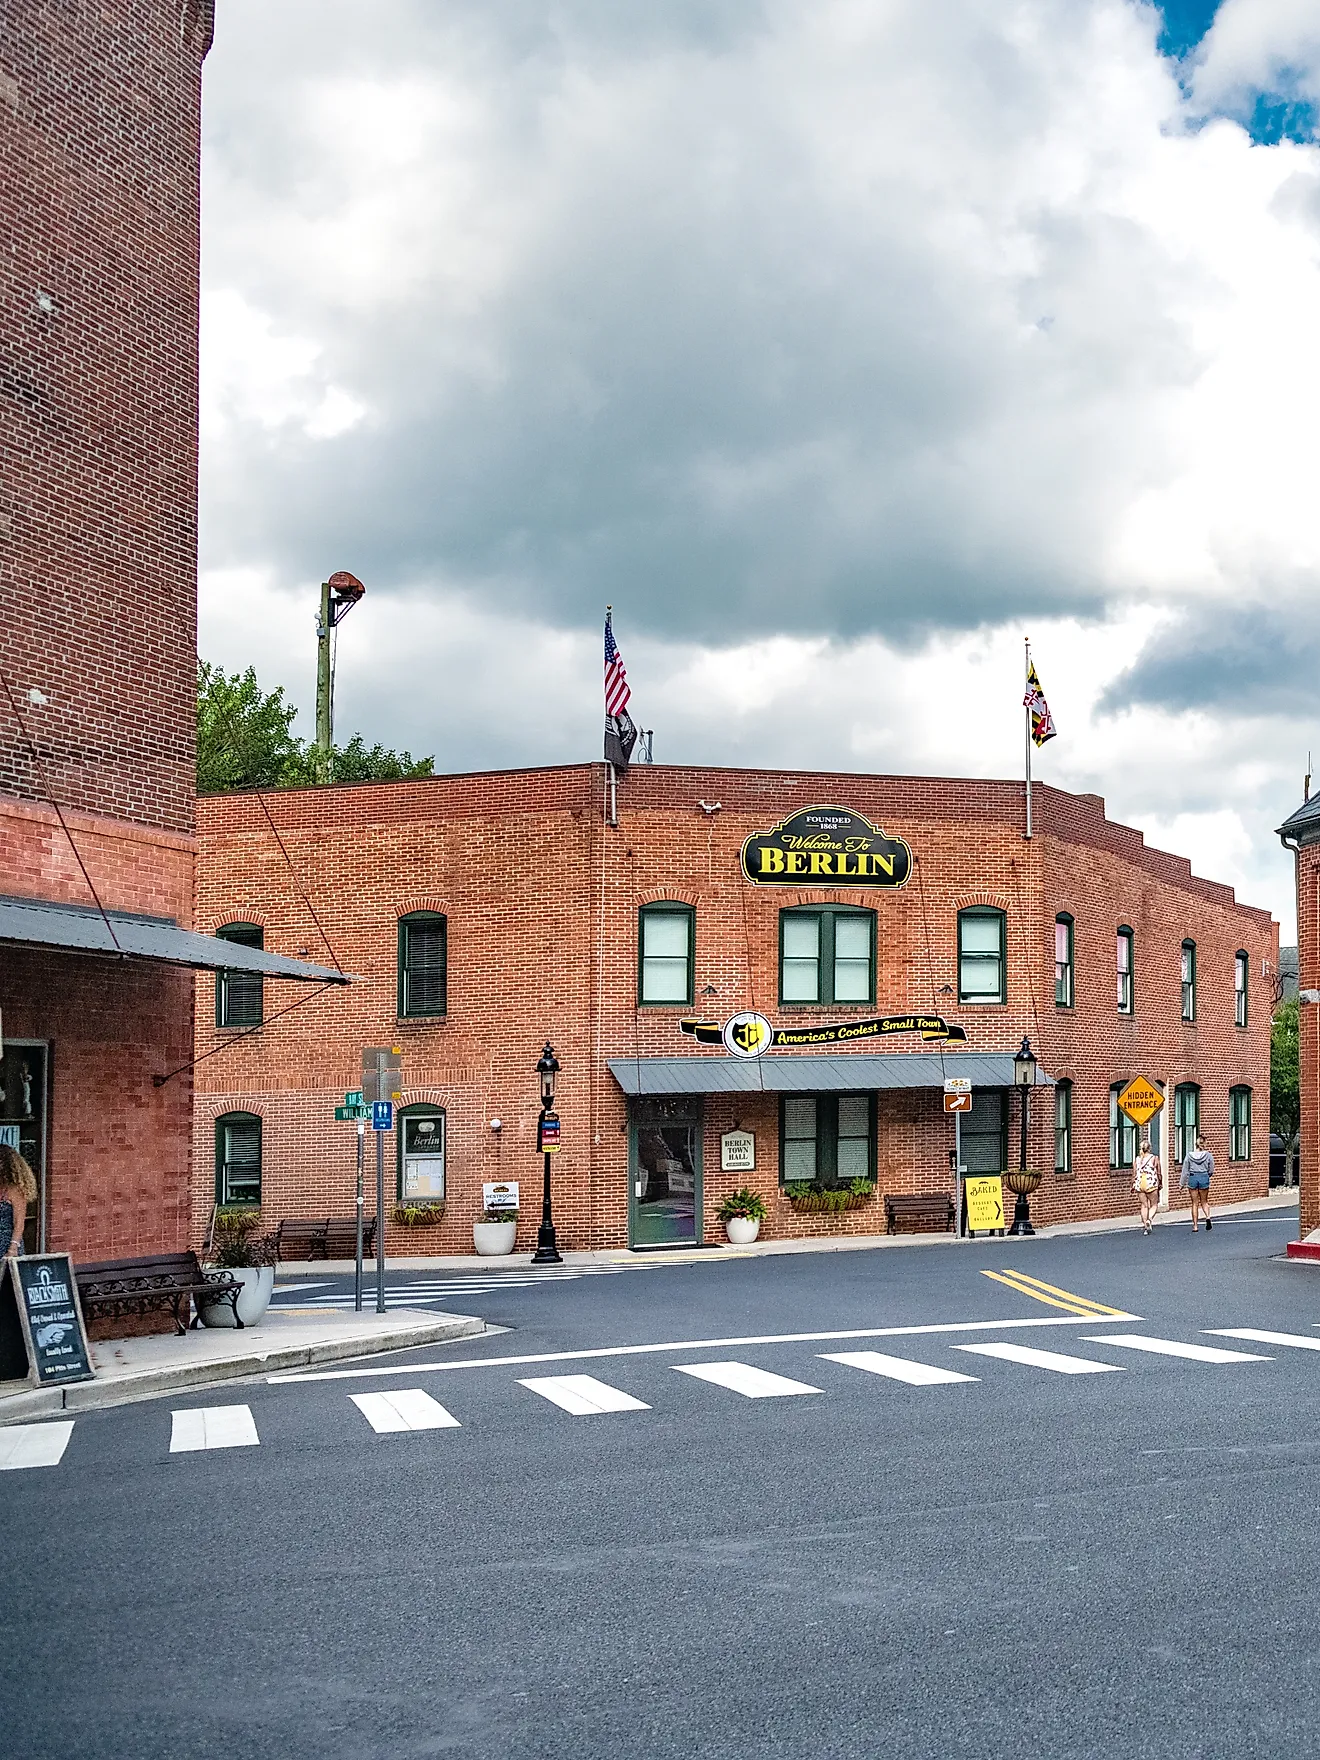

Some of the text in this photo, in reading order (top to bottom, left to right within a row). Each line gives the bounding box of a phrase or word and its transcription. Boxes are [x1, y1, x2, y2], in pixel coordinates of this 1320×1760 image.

[806, 816, 851, 824] FOUNDED
[781, 834, 874, 852] Welcome To
[758, 847, 896, 876] BERLIN
[777, 1018, 942, 1044] America's Coolest Small Town
[1128, 1092, 1154, 1100] HIDDEN
[1124, 1100, 1157, 1109] ENTRANCE
[413, 1135, 440, 1145] Berlin
[727, 1146, 749, 1154] TOWN
[970, 1186, 998, 1196] BAKED
[27, 1283, 69, 1305] BLACKSMITH
[45, 1366, 55, 1374] 104
[66, 1362, 81, 1370] Street
